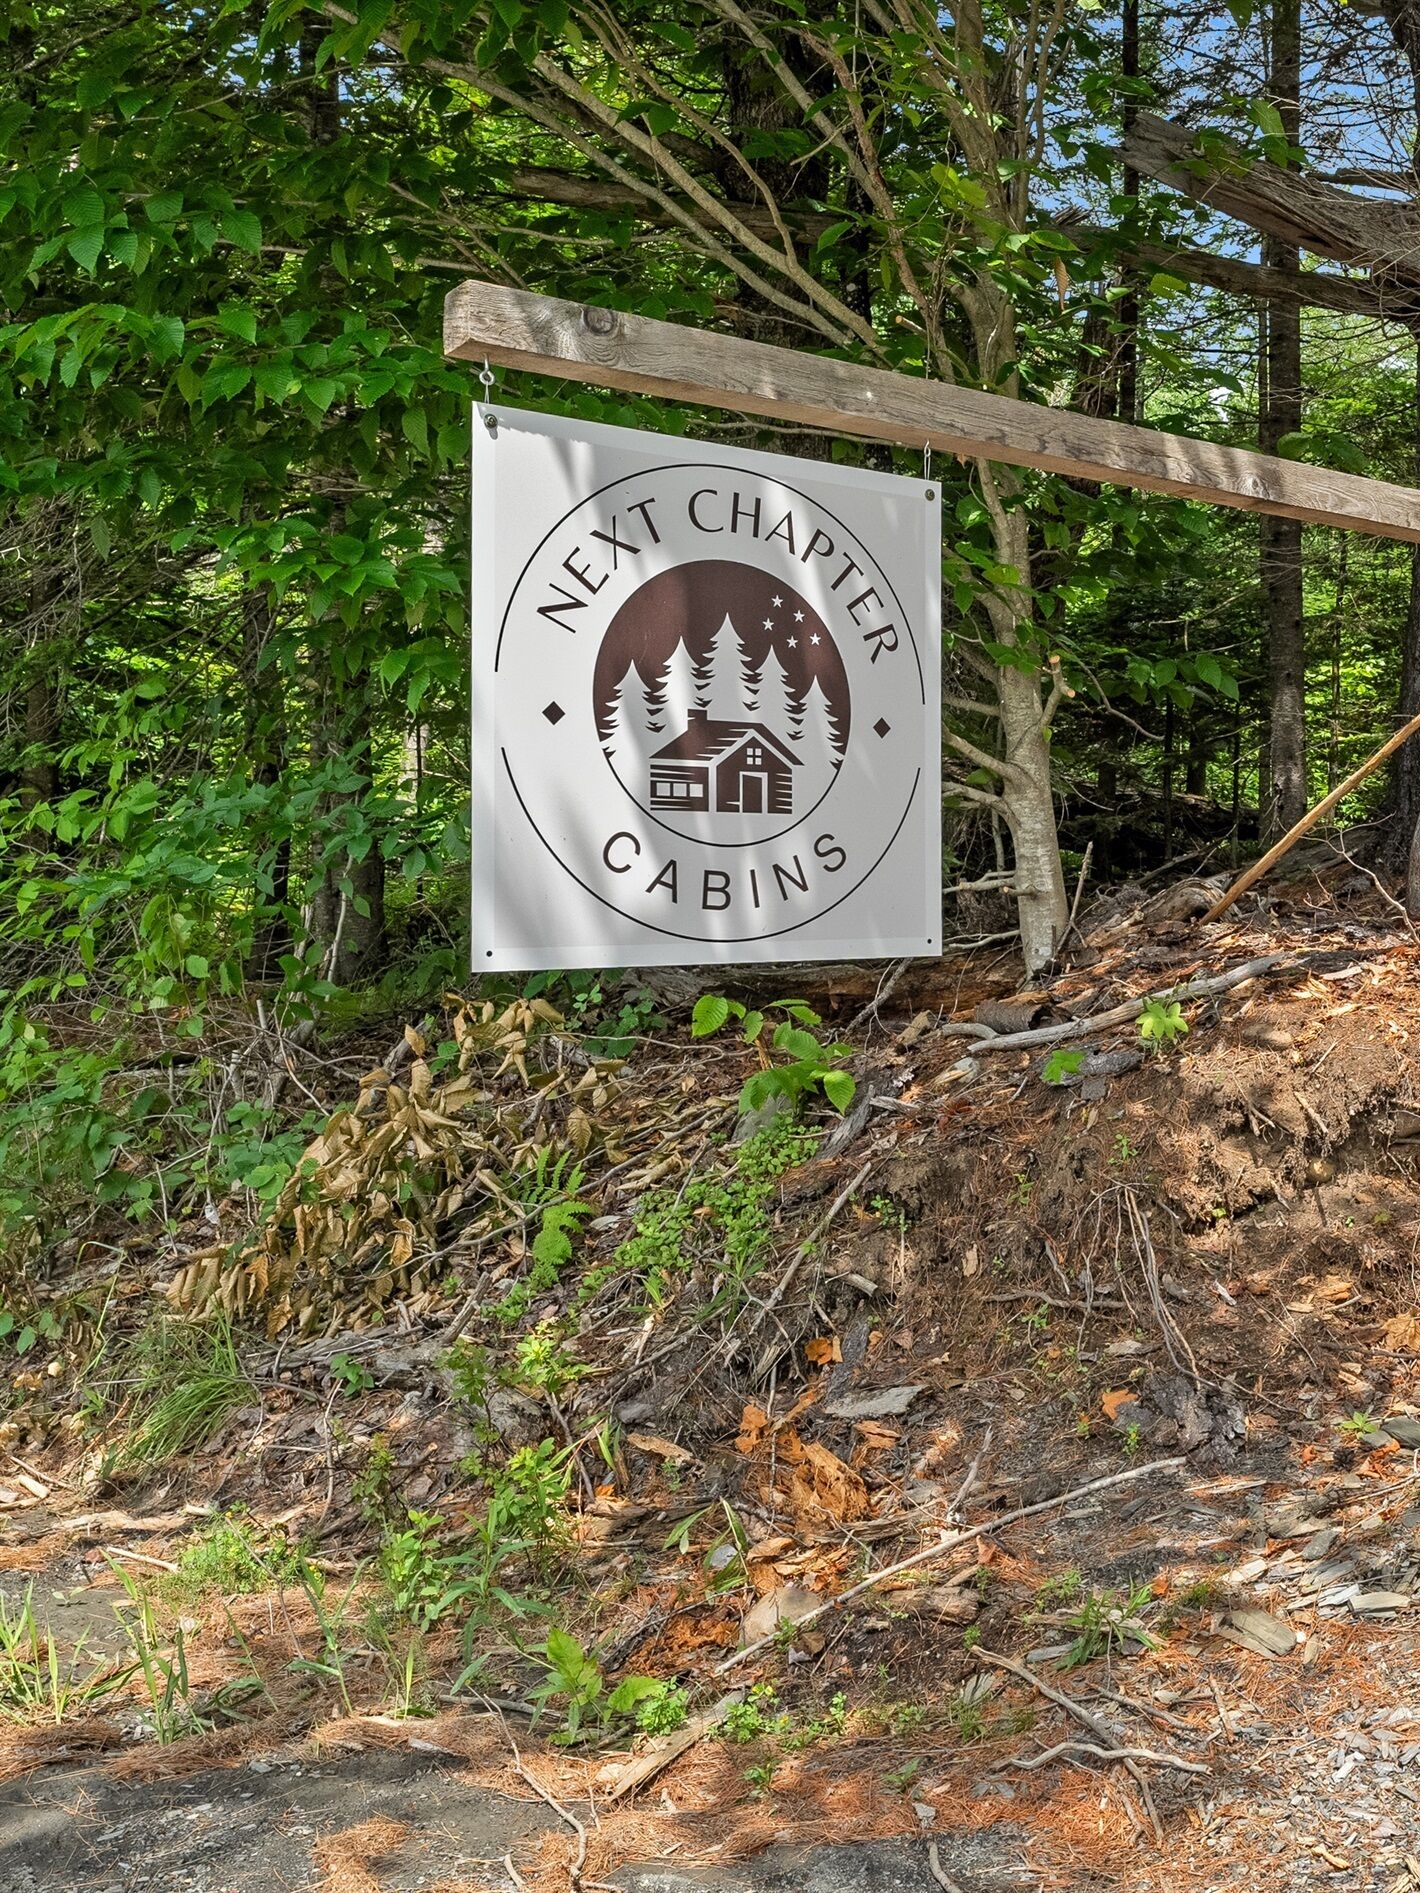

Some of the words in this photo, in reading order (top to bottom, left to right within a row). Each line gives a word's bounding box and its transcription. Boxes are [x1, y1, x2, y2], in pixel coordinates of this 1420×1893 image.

[537, 497, 662, 634] NEXT
[688, 488, 899, 665] CHAPTER
[602, 831, 847, 911] CABINS
